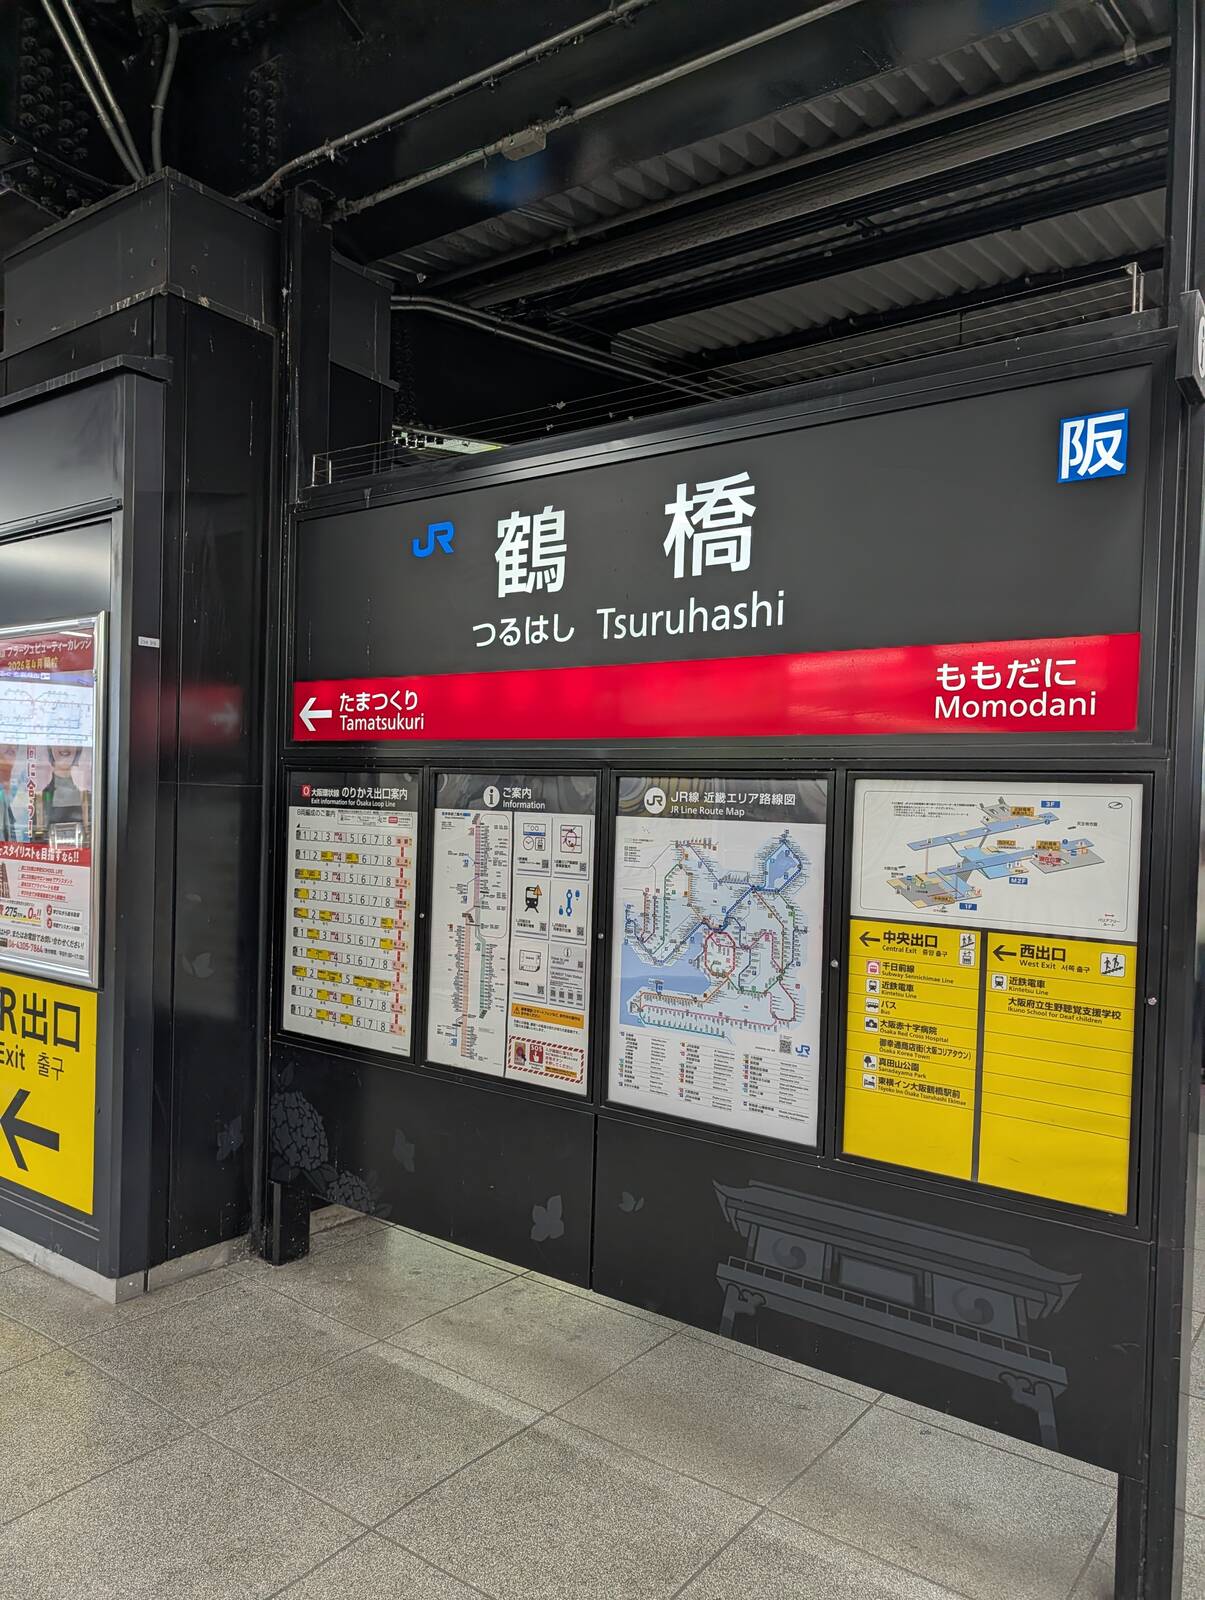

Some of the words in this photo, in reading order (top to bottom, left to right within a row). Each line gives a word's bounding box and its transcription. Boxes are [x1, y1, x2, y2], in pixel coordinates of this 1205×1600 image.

[1061, 412, 1125, 480] 阪
[413, 521, 455, 558] JR
[597, 590, 785, 640] Tsuruhashi
[472, 612, 575, 648] つるはし
[936, 658, 1077, 692] ももだに
[339, 690, 418, 712] たまつくり
[935, 691, 1096, 719] Momodani
[340, 712, 424, 732] Tamatsukuri
[342, 787, 408, 800] のりかえ出口案内
[503, 787, 532, 799] ご案内
[671, 792, 699, 803] JR線
[704, 792, 795, 805] 近畿エリア路線図
[503, 801, 545, 809] Information
[646, 795, 663, 806] JR
[681, 806, 697, 815] Line
[700, 807, 724, 815] Route
[726, 808, 744, 817] Map
[883, 930, 938, 948] 中央出口
[1020, 944, 1066, 962] 西出口
[883, 962, 914, 973] 千日前線
[905, 973, 940, 982] Sennichimae
[1009, 977, 1045, 988] 近鉄電車
[882, 981, 914, 992] 近鉄電車
[881, 1001, 896, 1009] バス
[1008, 997, 1121, 1020] 大阪府立生野聴覚支援学校
[1076, 1015, 1102, 1024] children
[880, 1020, 937, 1036] 大阪赤十字病院
[926, 1034, 948, 1043] Hospital
[796, 1045, 810, 1055] JR
[37, 1052, 64, 1081] 출구
[879, 1057, 919, 1071] 真田山公園
[878, 1077, 960, 1099] 東横イン大阪鶴橋駅前
